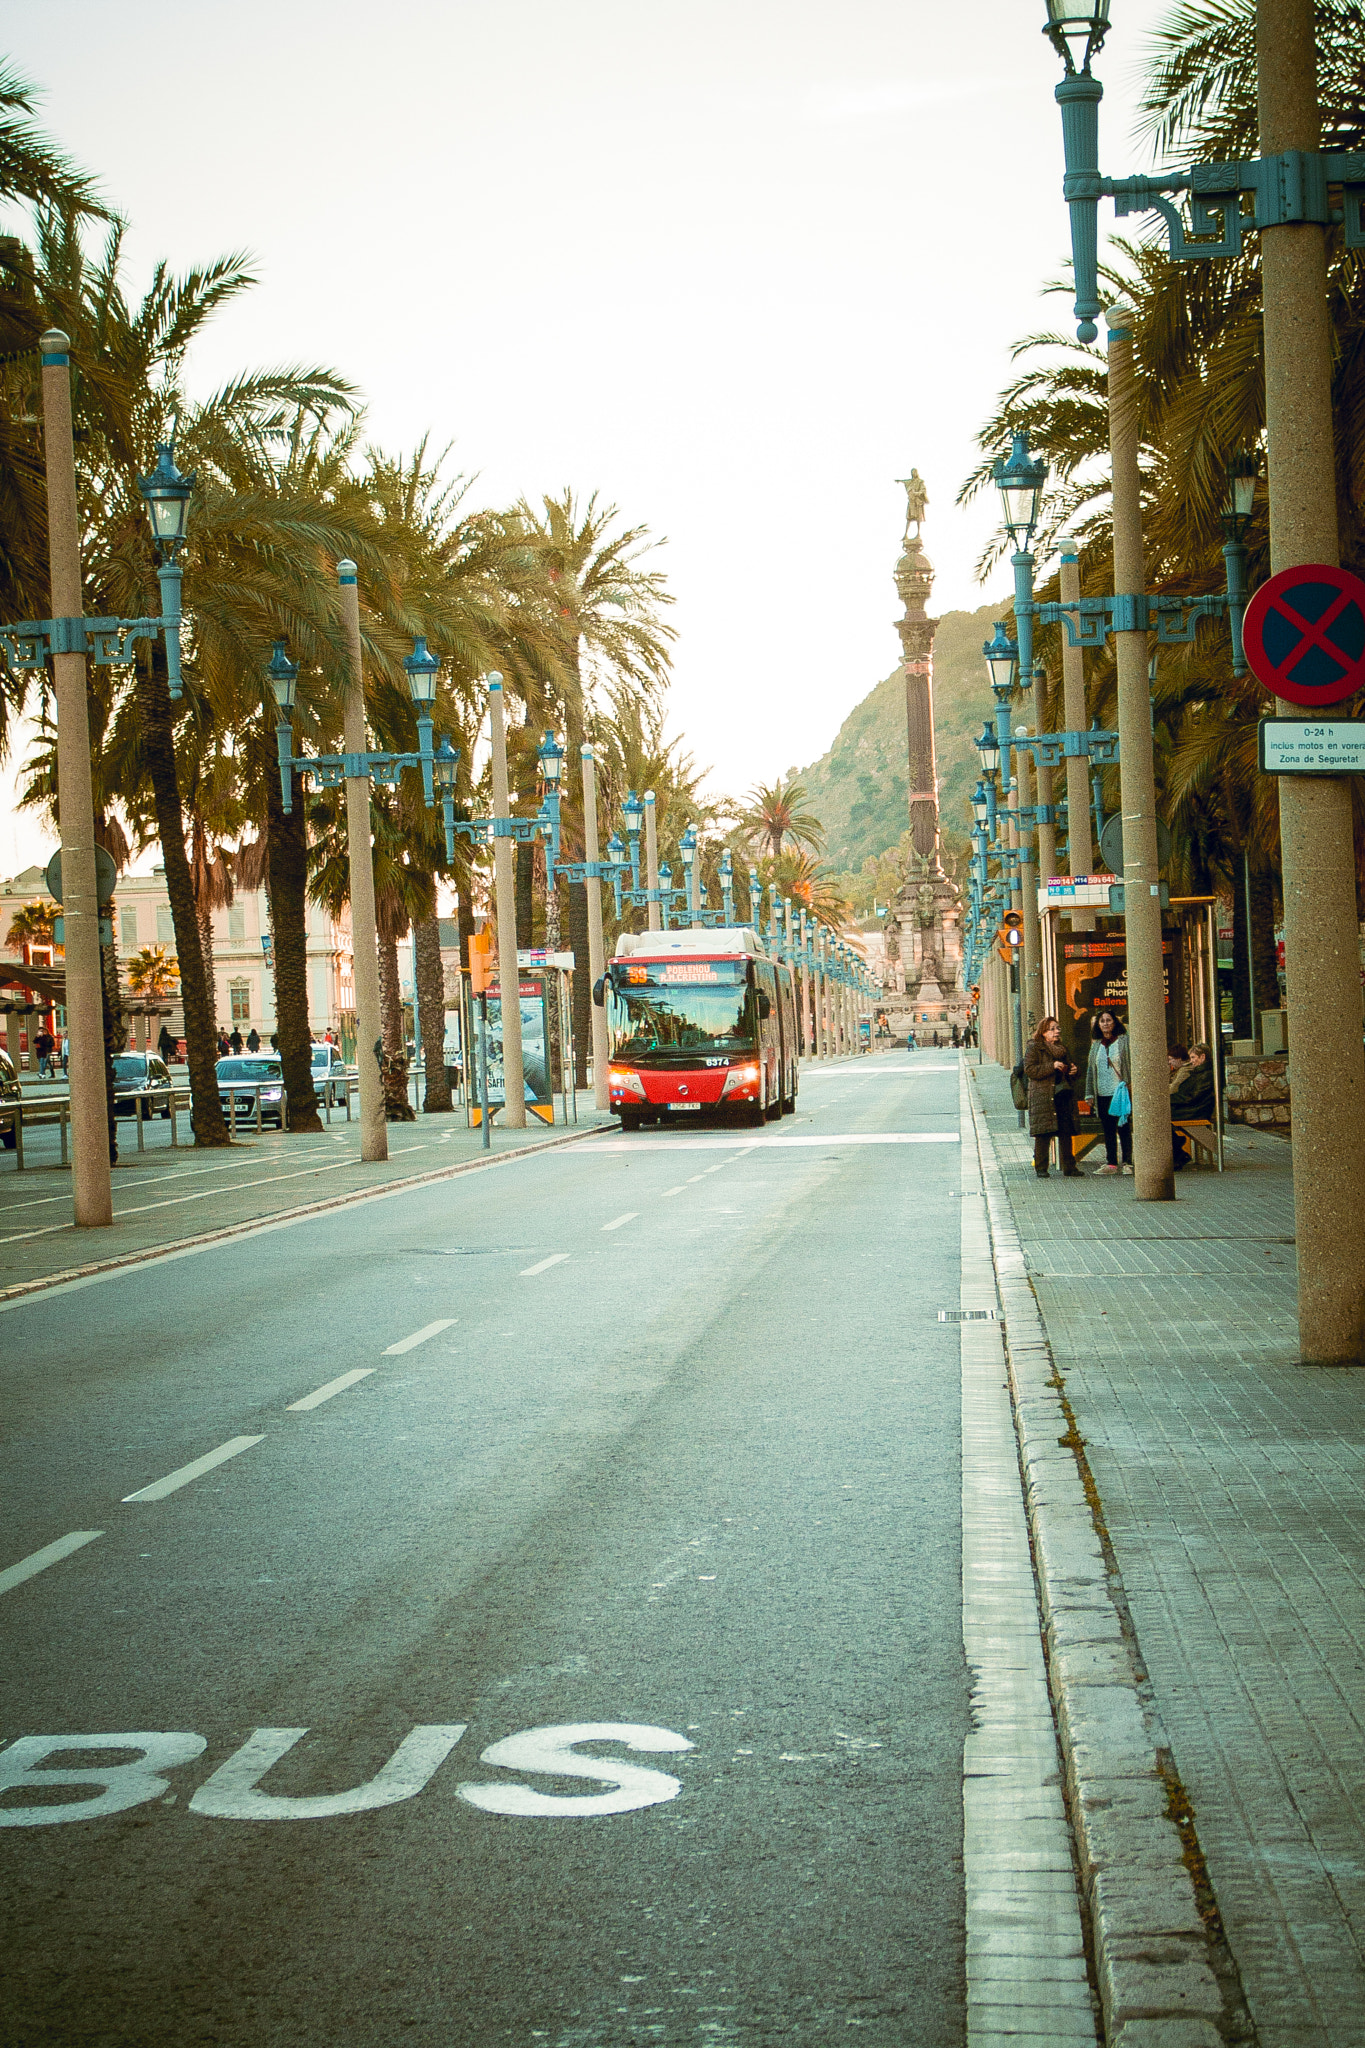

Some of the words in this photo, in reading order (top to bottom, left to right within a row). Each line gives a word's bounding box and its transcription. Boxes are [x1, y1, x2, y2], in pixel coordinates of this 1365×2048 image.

[1280, 755, 1300, 763] Zona
[1304, 755, 1314, 763] de
[1318, 755, 1359, 764] Seguretat
[1101, 875, 1112, 883] 64
[1103, 988, 1128, 997] iPhon
[1093, 997, 1127, 1007] Ballena
[706, 1059, 730, 1067] 6374
[0, 1722, 694, 1827] BUS
